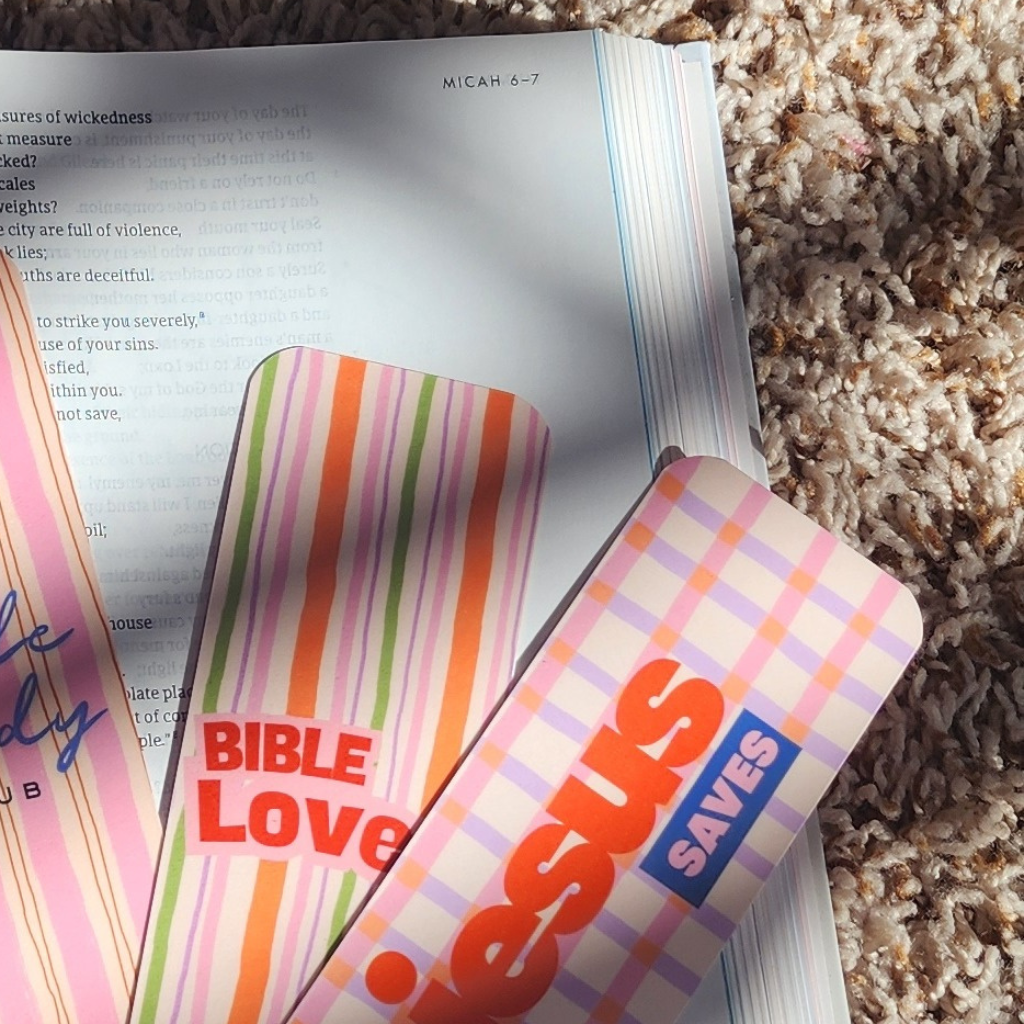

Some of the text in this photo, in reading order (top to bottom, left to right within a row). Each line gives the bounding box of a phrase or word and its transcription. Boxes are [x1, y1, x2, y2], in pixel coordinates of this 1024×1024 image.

[442, 74, 500, 89] MICAH
[63, 110, 152, 124] wickedness
[6, 134, 72, 146] measure
[8, 222, 35, 239] city
[39, 225, 64, 236] are
[67, 222, 92, 236] full
[96, 222, 111, 236] of
[114, 222, 181, 237] violence,
[16, 244, 46, 260] lies;
[56, 267, 154, 282] are deceitful.
[36, 314, 130, 331] to strike you
[67, 336, 158, 354] of your sins.
[89, 386, 122, 400] you.
[84, 409, 121, 422] save,
[203, 721, 372, 786] BIBLE
[668, 730, 780, 878] SAVES
